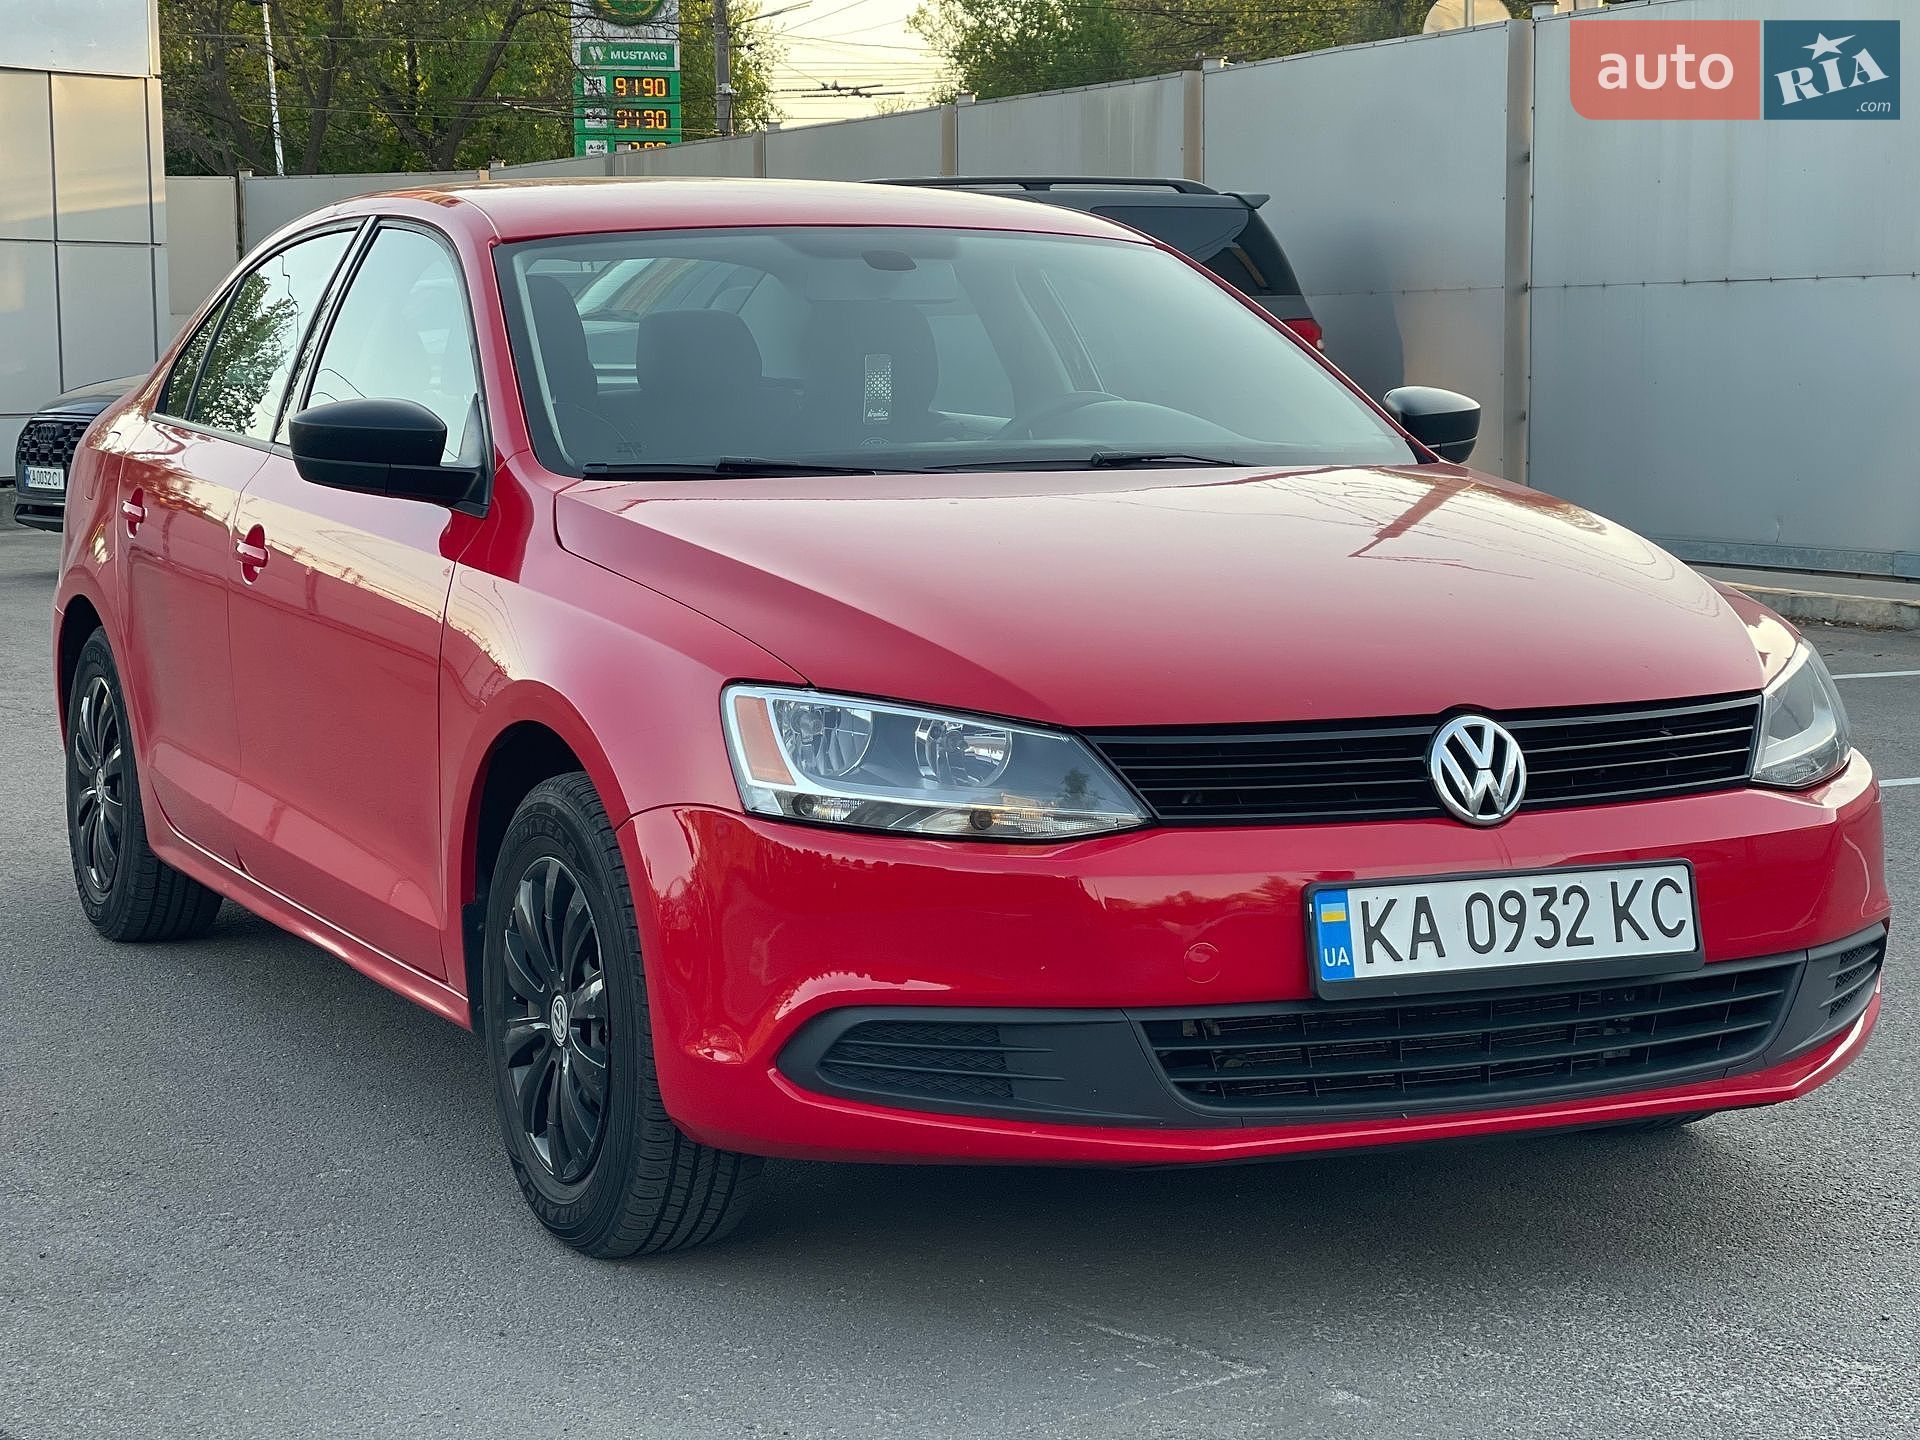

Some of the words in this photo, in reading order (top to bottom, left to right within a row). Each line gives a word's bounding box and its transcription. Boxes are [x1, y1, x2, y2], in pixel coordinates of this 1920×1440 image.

[610, 50, 668, 61] MUSTANG
[1361, 895, 1446, 964] KA
[1464, 884, 1594, 955] 0932
[1610, 877, 1686, 943] KC
[1324, 948, 1350, 968] UA
